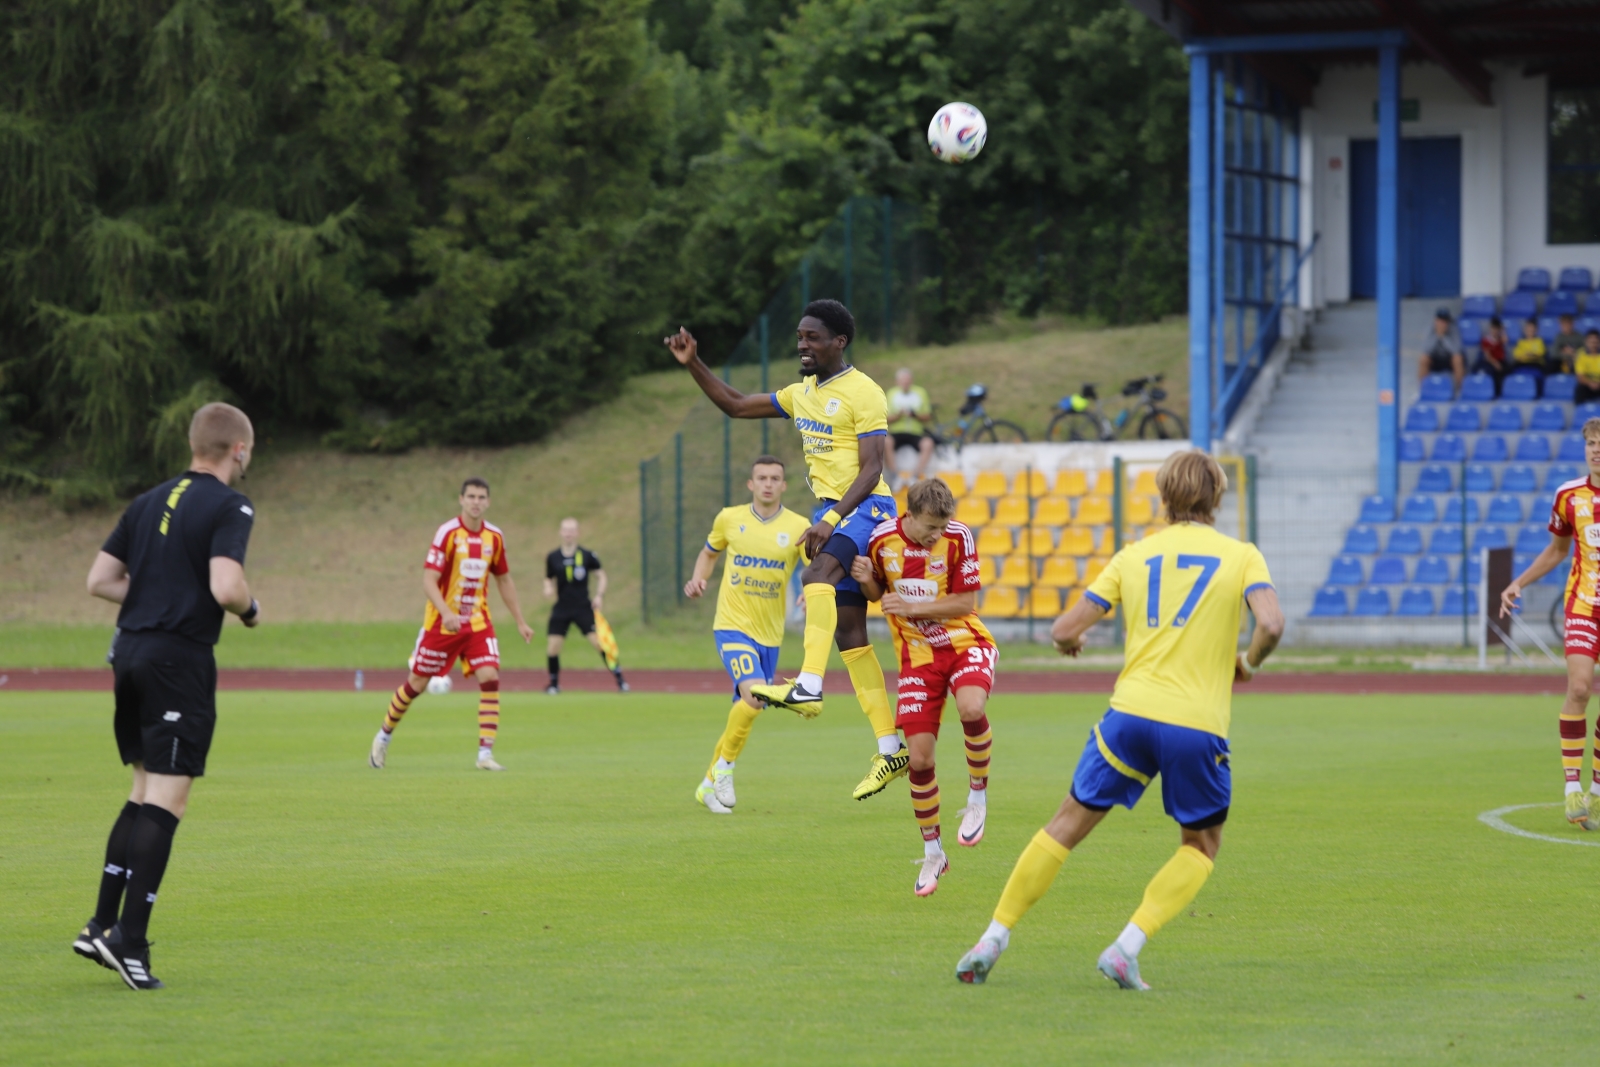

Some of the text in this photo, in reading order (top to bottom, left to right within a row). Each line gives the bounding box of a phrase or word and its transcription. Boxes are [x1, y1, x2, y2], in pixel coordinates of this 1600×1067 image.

[795, 416, 833, 436] GDYNIA
[733, 554, 785, 570] GDYNIA
[744, 576, 781, 592] Energa
[898, 585, 935, 597] Skiba
[1145, 554, 1221, 628] 17
[730, 653, 755, 681] 80
